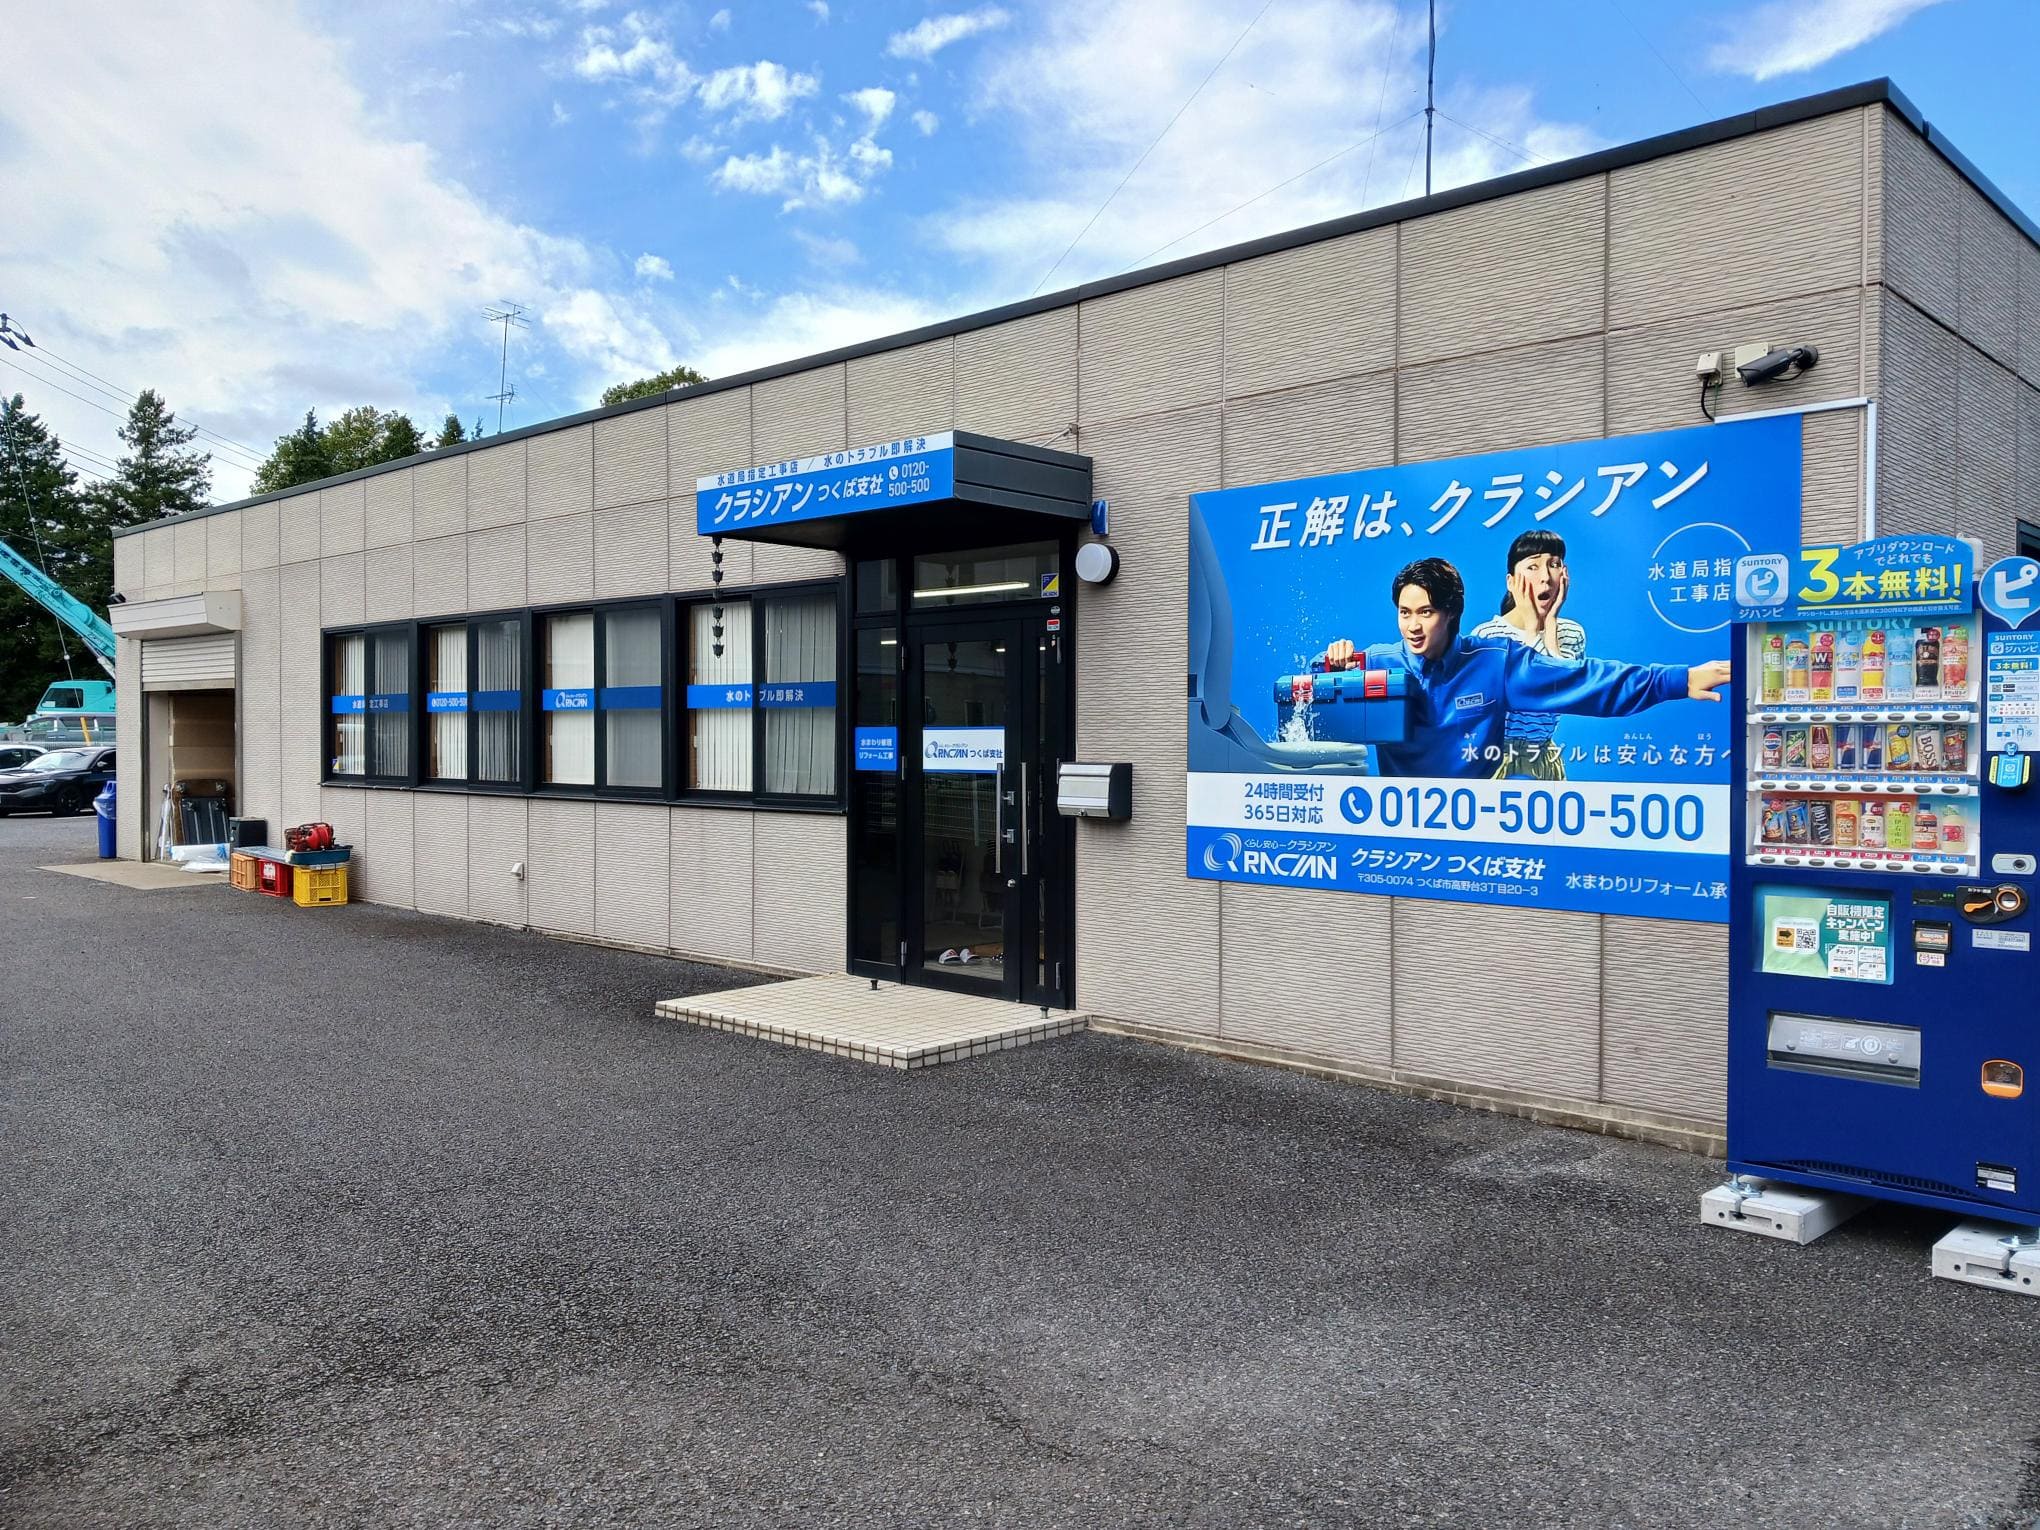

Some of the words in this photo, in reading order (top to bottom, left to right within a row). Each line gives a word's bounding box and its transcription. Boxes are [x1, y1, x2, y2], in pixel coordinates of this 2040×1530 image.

[888, 477, 930, 497] 500-500
[714, 482, 814, 525] クラシアン
[817, 473, 885, 503] つくば支社
[1854, 541, 1956, 561] アプリダウンロード
[1874, 552, 1934, 567] でどれでも
[1648, 557, 1736, 581] 水道局指
[1741, 557, 1783, 567] SUNTORY
[1670, 583, 1731, 602] 工事店
[1751, 572, 1774, 597] ピ
[1994, 564, 2039, 609] ピ
[726, 688, 804, 703] 水のトブル即解決
[1623, 732, 1653, 740] あんしん
[969, 749, 1004, 759] つくば支社
[1920, 735, 1937, 766] BOSS
[1244, 782, 1324, 802] 24時間受付
[1244, 804, 1324, 824] 365日対応
[1379, 785, 1704, 841] 0120-500-500
[1351, 847, 1441, 872] クラシアン
[1447, 855, 1547, 881] つくば支社
[1827, 904, 1885, 919] 自販機限定
[1826, 917, 1885, 931] キャンペーン
